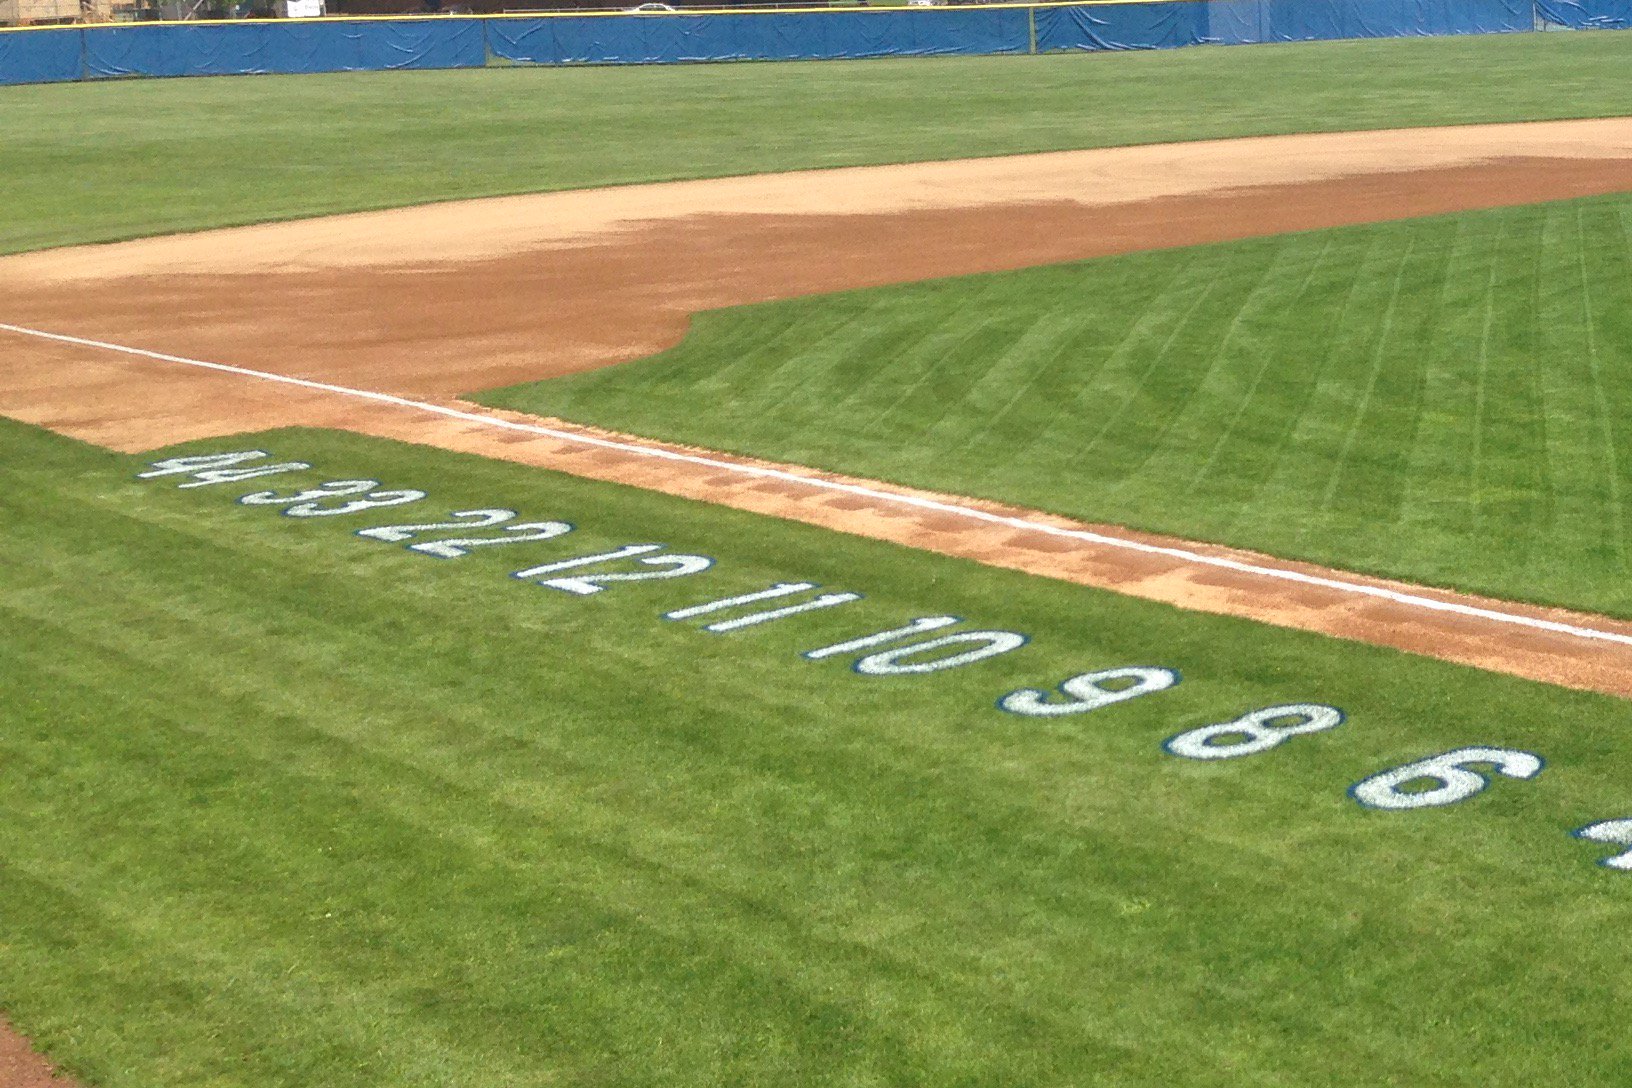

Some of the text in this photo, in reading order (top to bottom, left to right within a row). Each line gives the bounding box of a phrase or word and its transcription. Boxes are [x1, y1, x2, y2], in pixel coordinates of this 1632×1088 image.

[135, 448, 312, 489] 44
[238, 478, 428, 518] 33
[354, 505, 575, 560] 22
[511, 541, 717, 598] 12
[661, 580, 862, 635] 11
[799, 613, 1028, 678] 10
[999, 665, 1179, 718] 9
[1164, 702, 1346, 762] 8
[1350, 744, 1545, 812] 6
